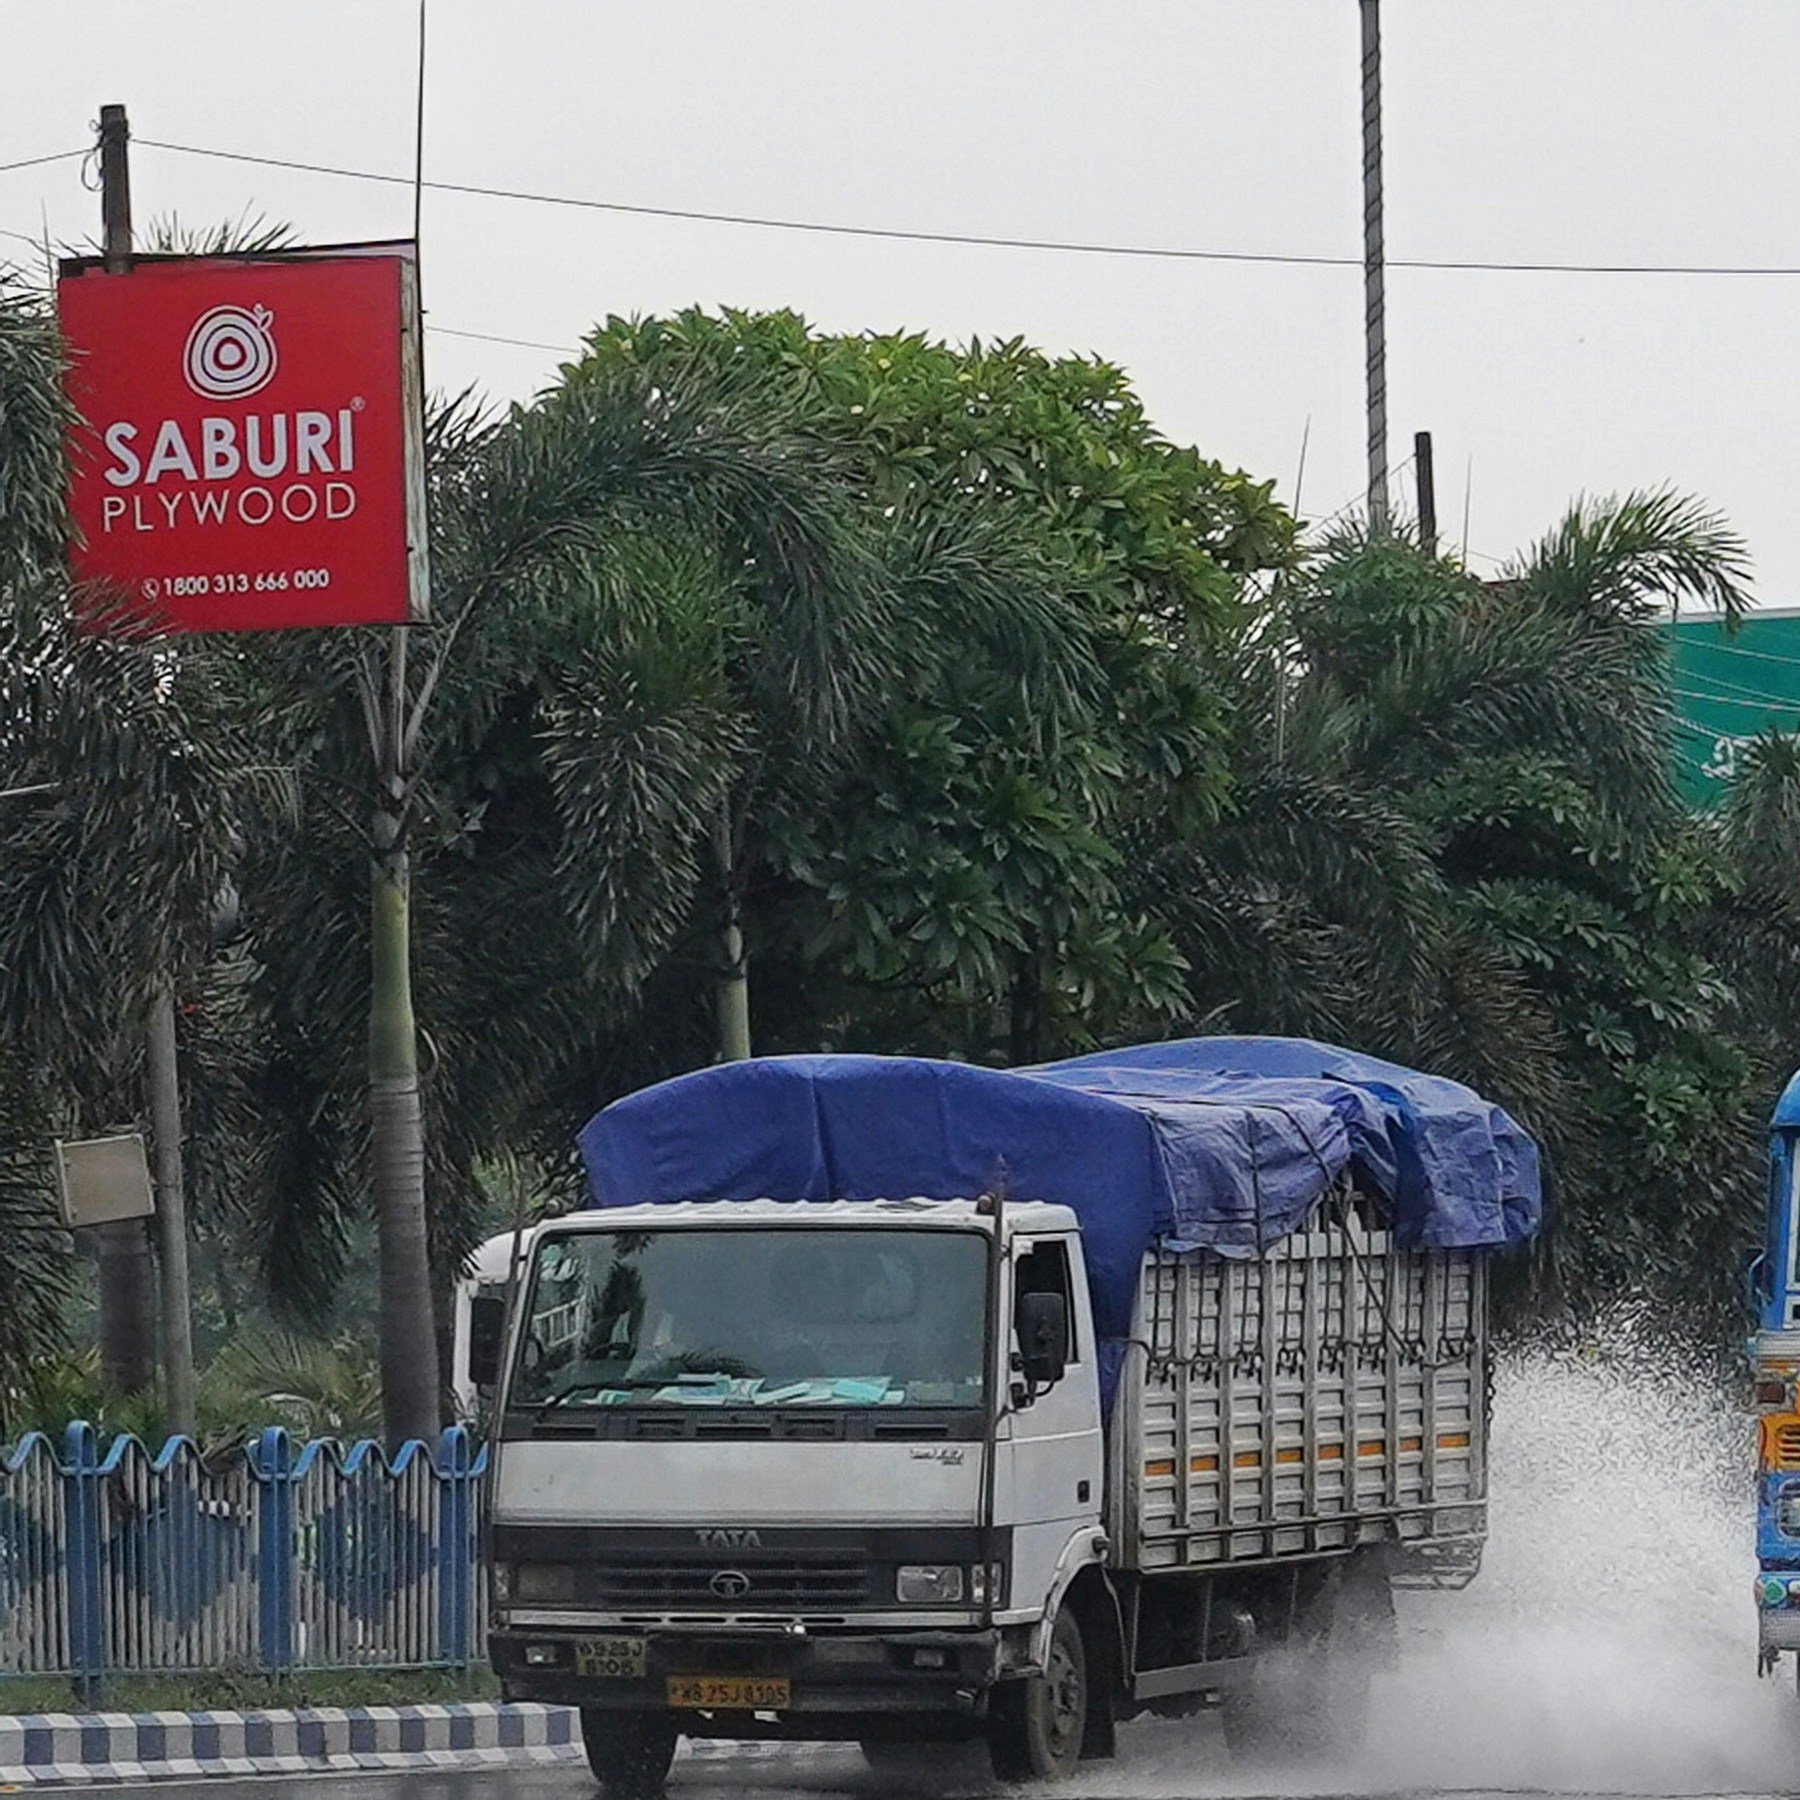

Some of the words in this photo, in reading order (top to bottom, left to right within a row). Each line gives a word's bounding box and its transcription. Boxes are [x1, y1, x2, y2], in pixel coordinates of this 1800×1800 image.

[103, 409, 355, 488] SABURI
[102, 482, 357, 533] PLYWOOD
[163, 575, 210, 597] 1800
[213, 573, 250, 594] 313
[254, 571, 289, 592] 666
[293, 568, 330, 589] 000
[695, 1529, 762, 1549] TATA
